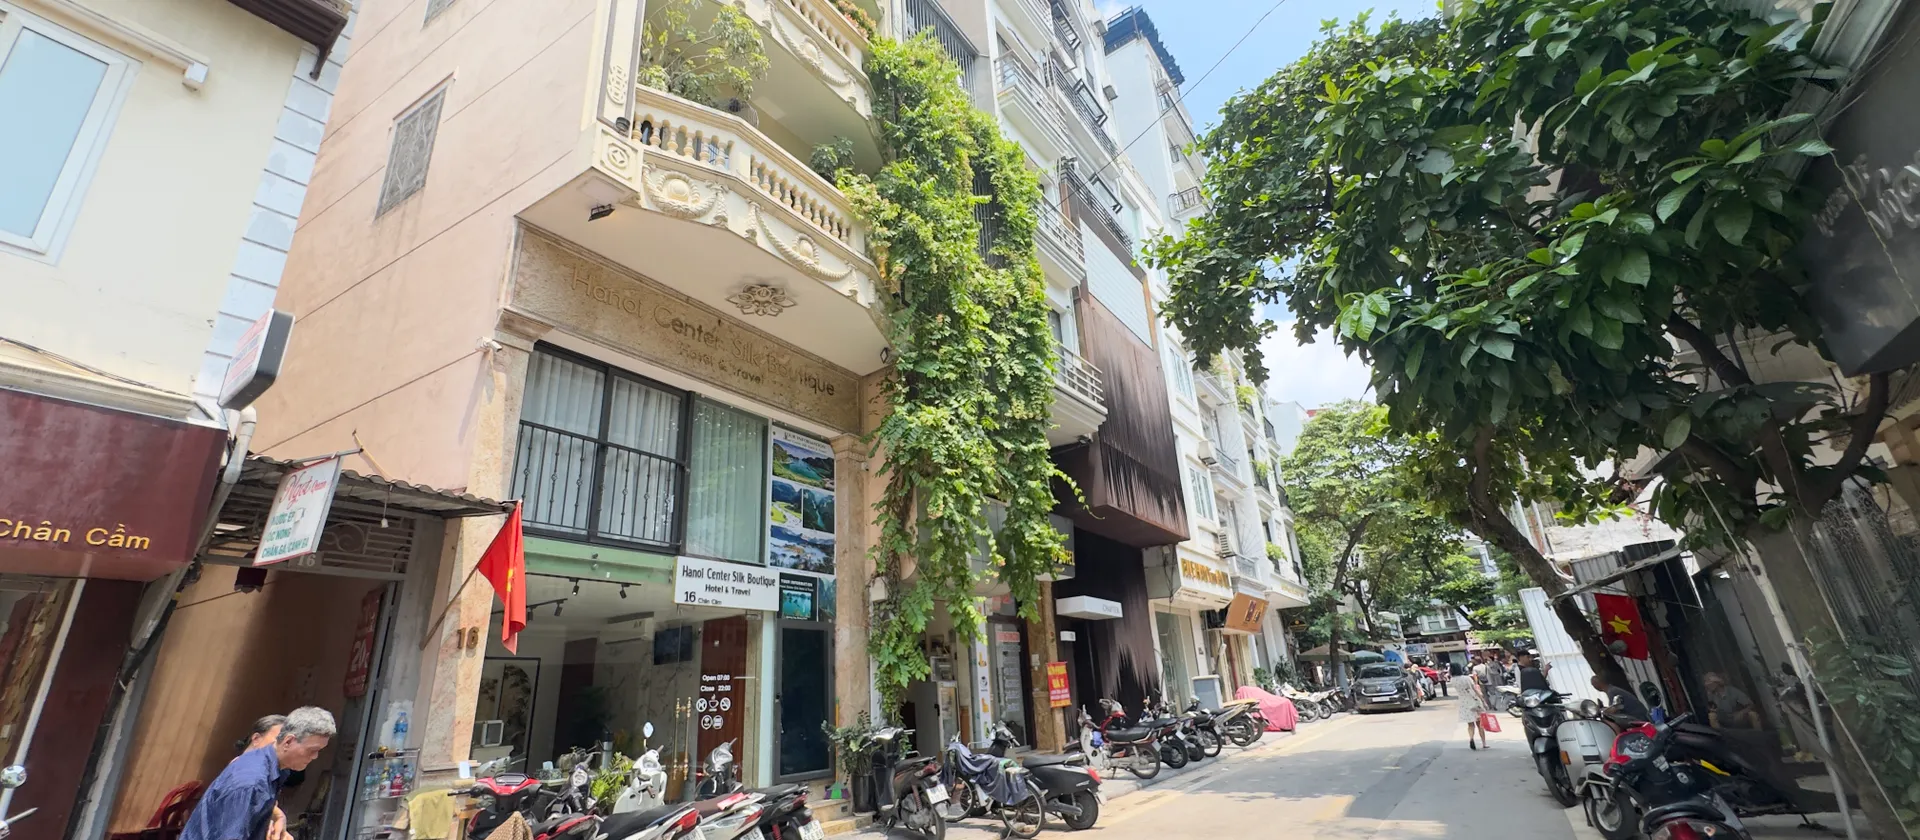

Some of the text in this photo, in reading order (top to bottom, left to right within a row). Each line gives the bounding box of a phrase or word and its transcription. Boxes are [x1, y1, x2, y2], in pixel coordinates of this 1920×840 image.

[570, 266, 644, 319] Hanoi
[653, 303, 723, 349] Center
[731, 337, 761, 368] Silk
[0, 518, 150, 550] Chân Cầm
[297, 554, 316, 567] 16
[682, 565, 704, 579] Hanoi
[706, 568, 731, 582] Center
[732, 571, 746, 584] Silk
[747, 573, 776, 588] Boutique
[684, 591, 696, 603] 16
[704, 584, 751, 596] Hotel & Travel
[456, 627, 479, 650] 16
[702, 674, 717, 682] Open
